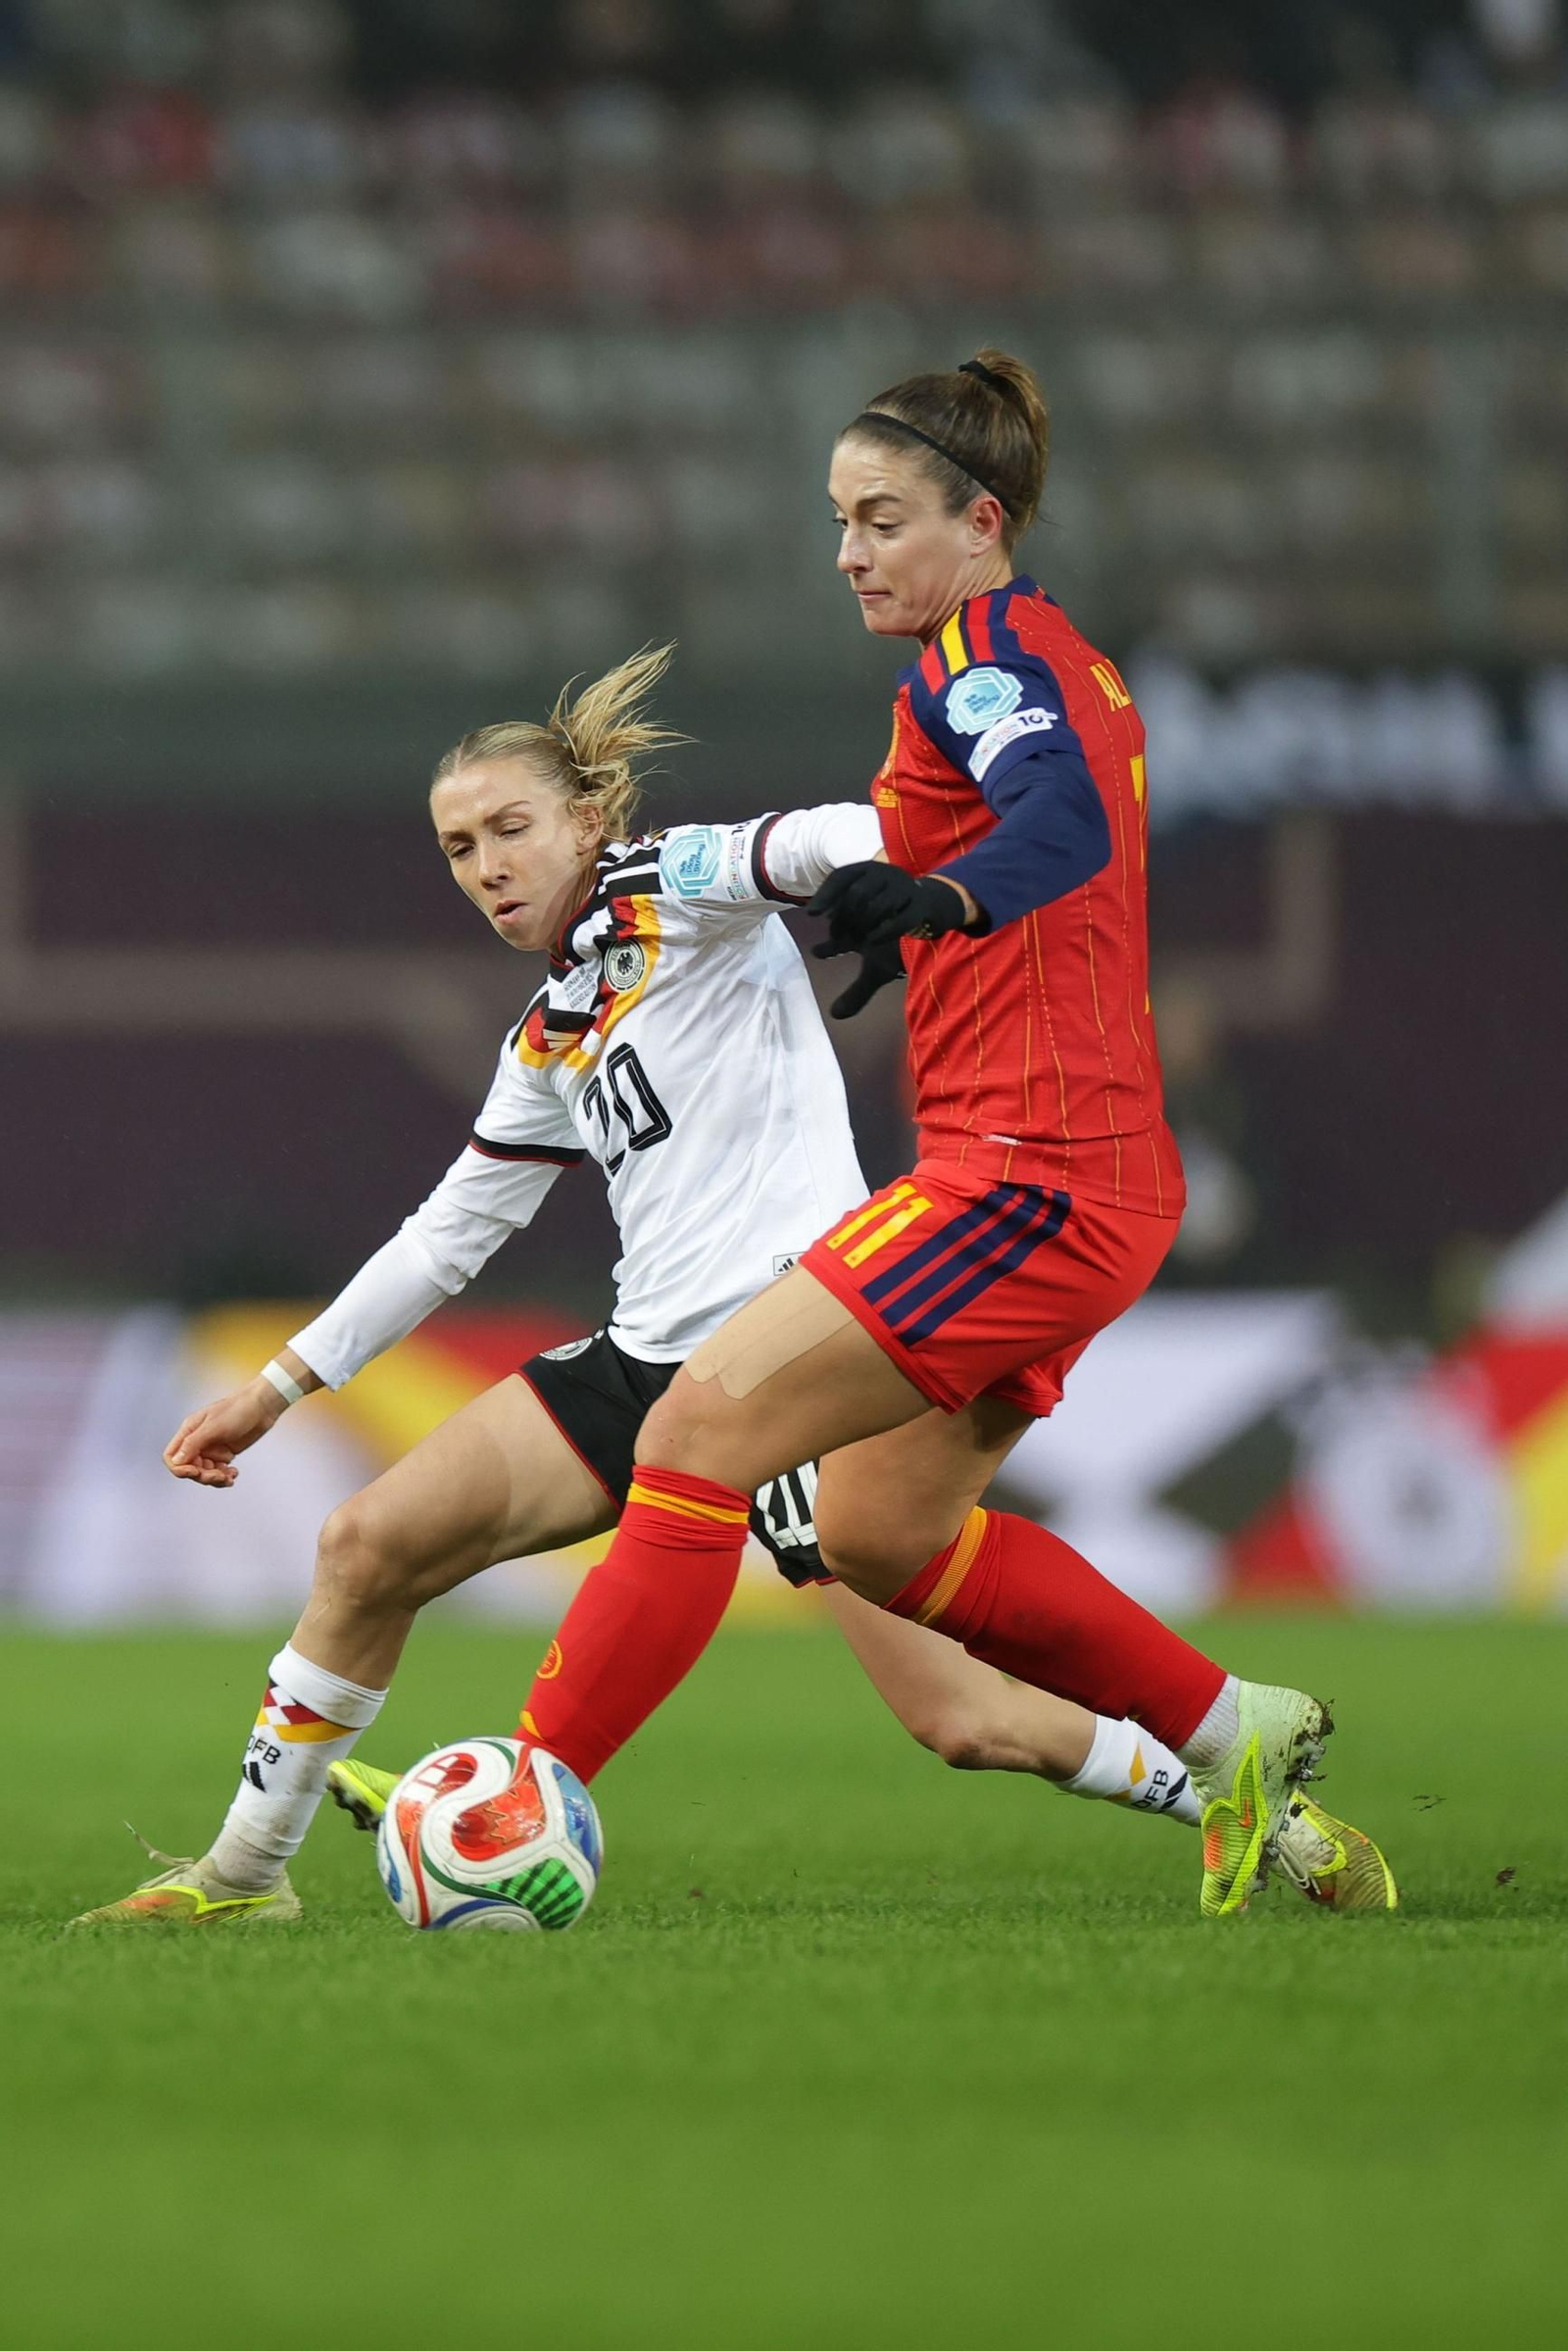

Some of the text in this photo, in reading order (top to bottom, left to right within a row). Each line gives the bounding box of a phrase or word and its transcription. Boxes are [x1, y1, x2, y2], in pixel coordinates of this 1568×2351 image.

[1089, 658, 1133, 712] AL
[582, 1041, 673, 1178] 20
[826, 1182, 934, 1270] 11
[247, 1735, 282, 1765] DFB
[1131, 1769, 1169, 1810] DFB
